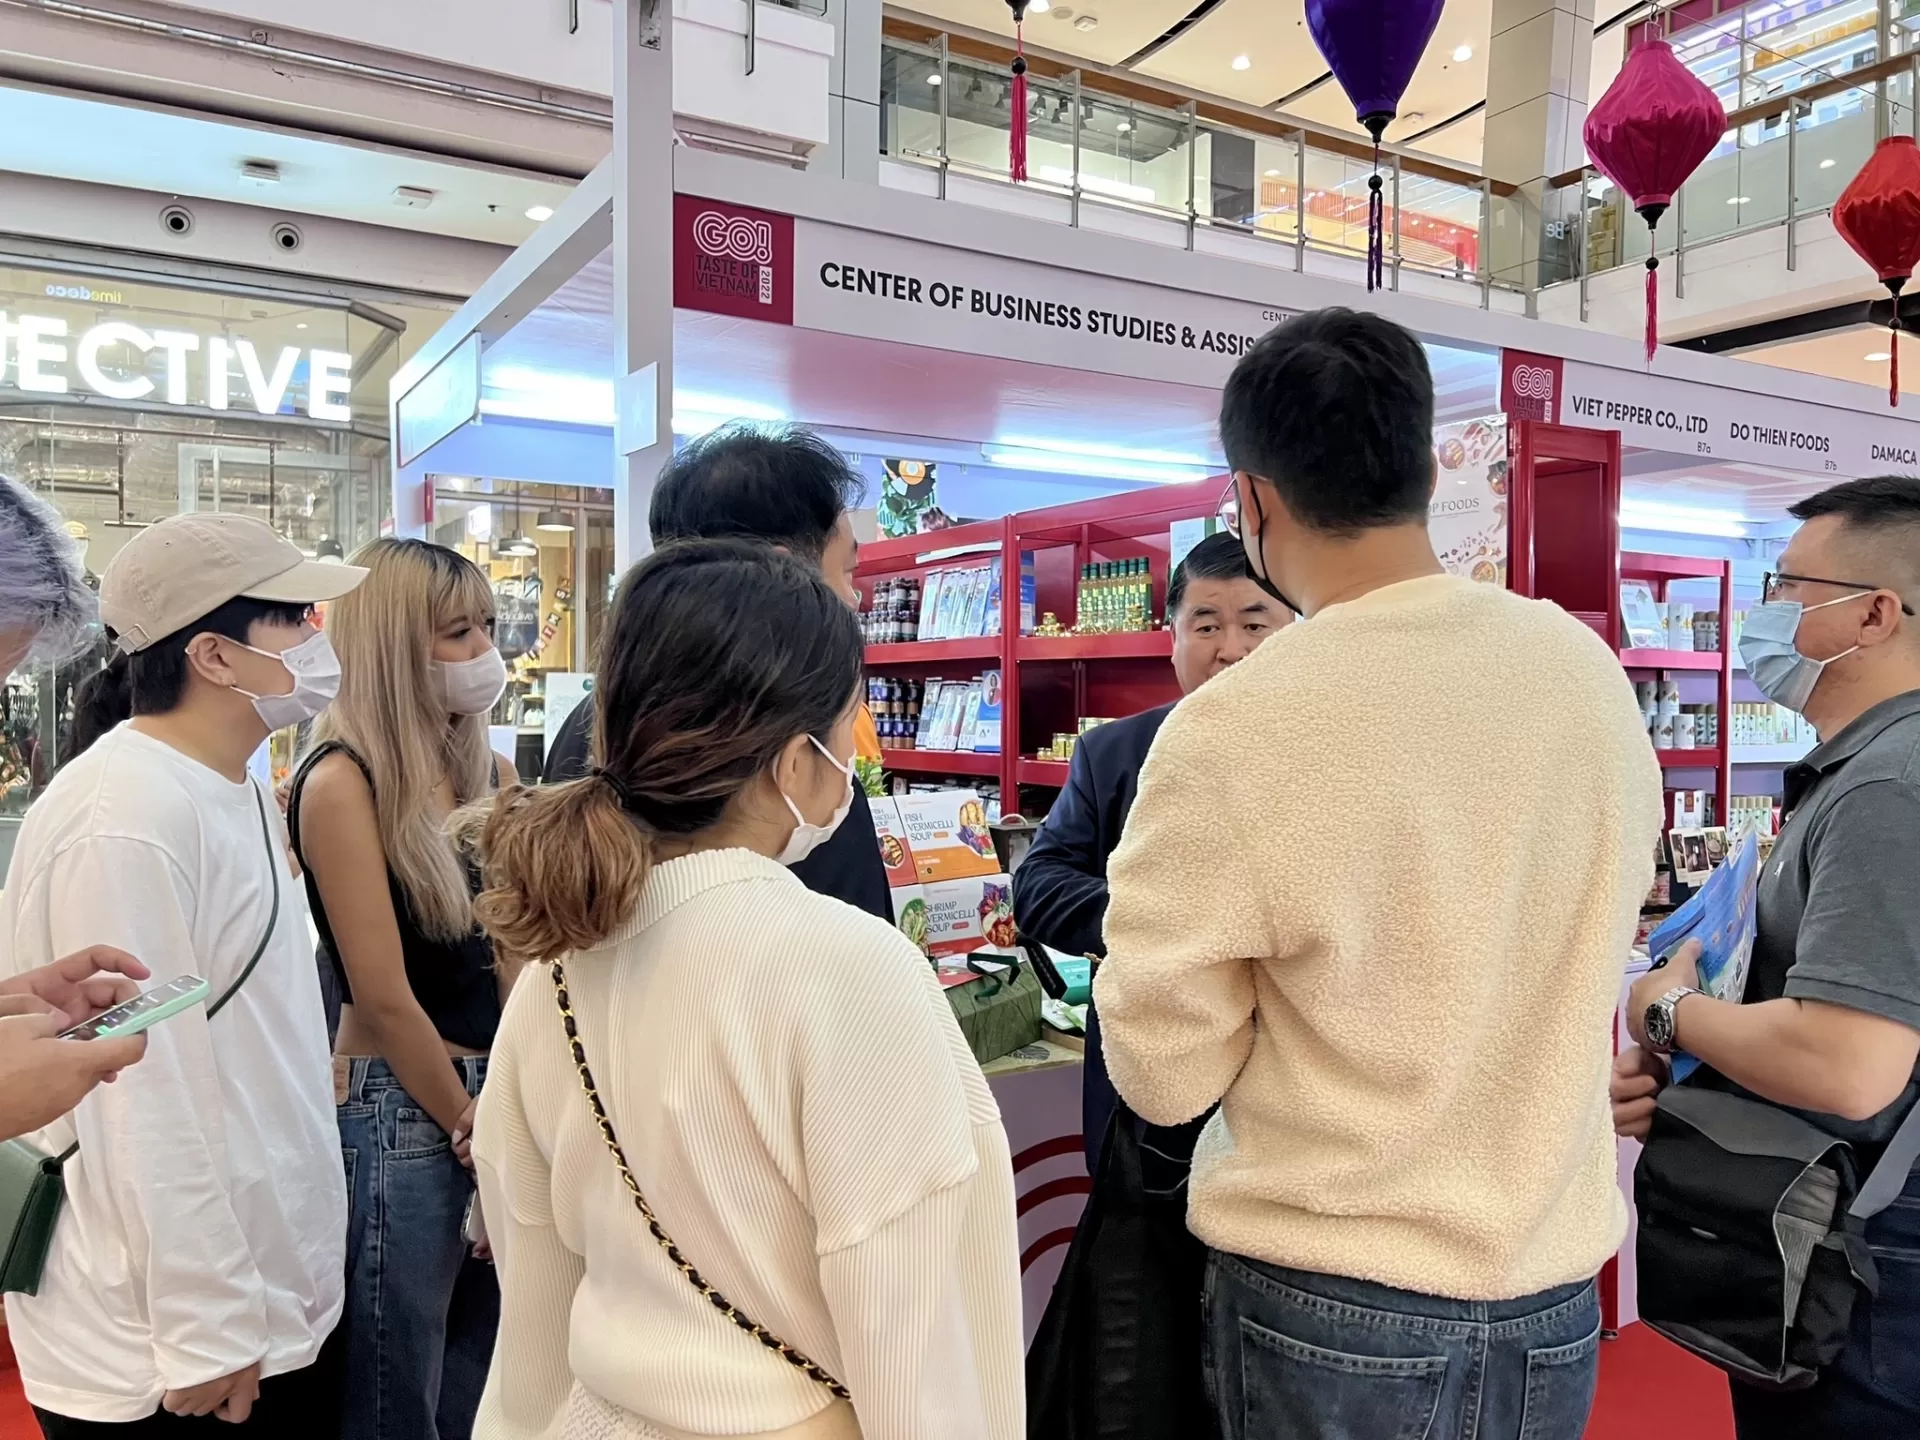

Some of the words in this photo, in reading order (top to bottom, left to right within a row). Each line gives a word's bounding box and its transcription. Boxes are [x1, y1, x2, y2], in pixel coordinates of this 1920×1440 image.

[693, 211, 773, 264] GO!
[695, 254, 738, 277] TASTE
[741, 262, 758, 280] OF
[695, 271, 757, 295] VIETNAM
[760, 269, 771, 300] 2022
[820, 262, 923, 304] CENTER
[929, 282, 964, 309] OF
[971, 289, 1082, 330] BUSINESS
[1087, 309, 1176, 346] STUDIES
[1181, 326, 1196, 349] &
[1512, 364, 1554, 400] GO!
[1572, 395, 1603, 420] VIET
[1606, 401, 1653, 426] PEPPER
[1655, 410, 1683, 432] CO.,
[1686, 415, 1708, 434] LTD
[1730, 422, 1750, 441] DO
[1753, 426, 1787, 447] THIEN
[1790, 432, 1830, 453] FOODS
[1871, 444, 1918, 466] DAMACA
[1441, 497, 1480, 512] FOODS
[904, 813, 923, 822] FISH
[907, 819, 954, 832] VERMICELLI
[910, 831, 932, 842] SOUP
[925, 900, 958, 913] SHRIMP
[926, 909, 976, 923] VERMICELLI
[927, 922, 951, 933] SOUP
